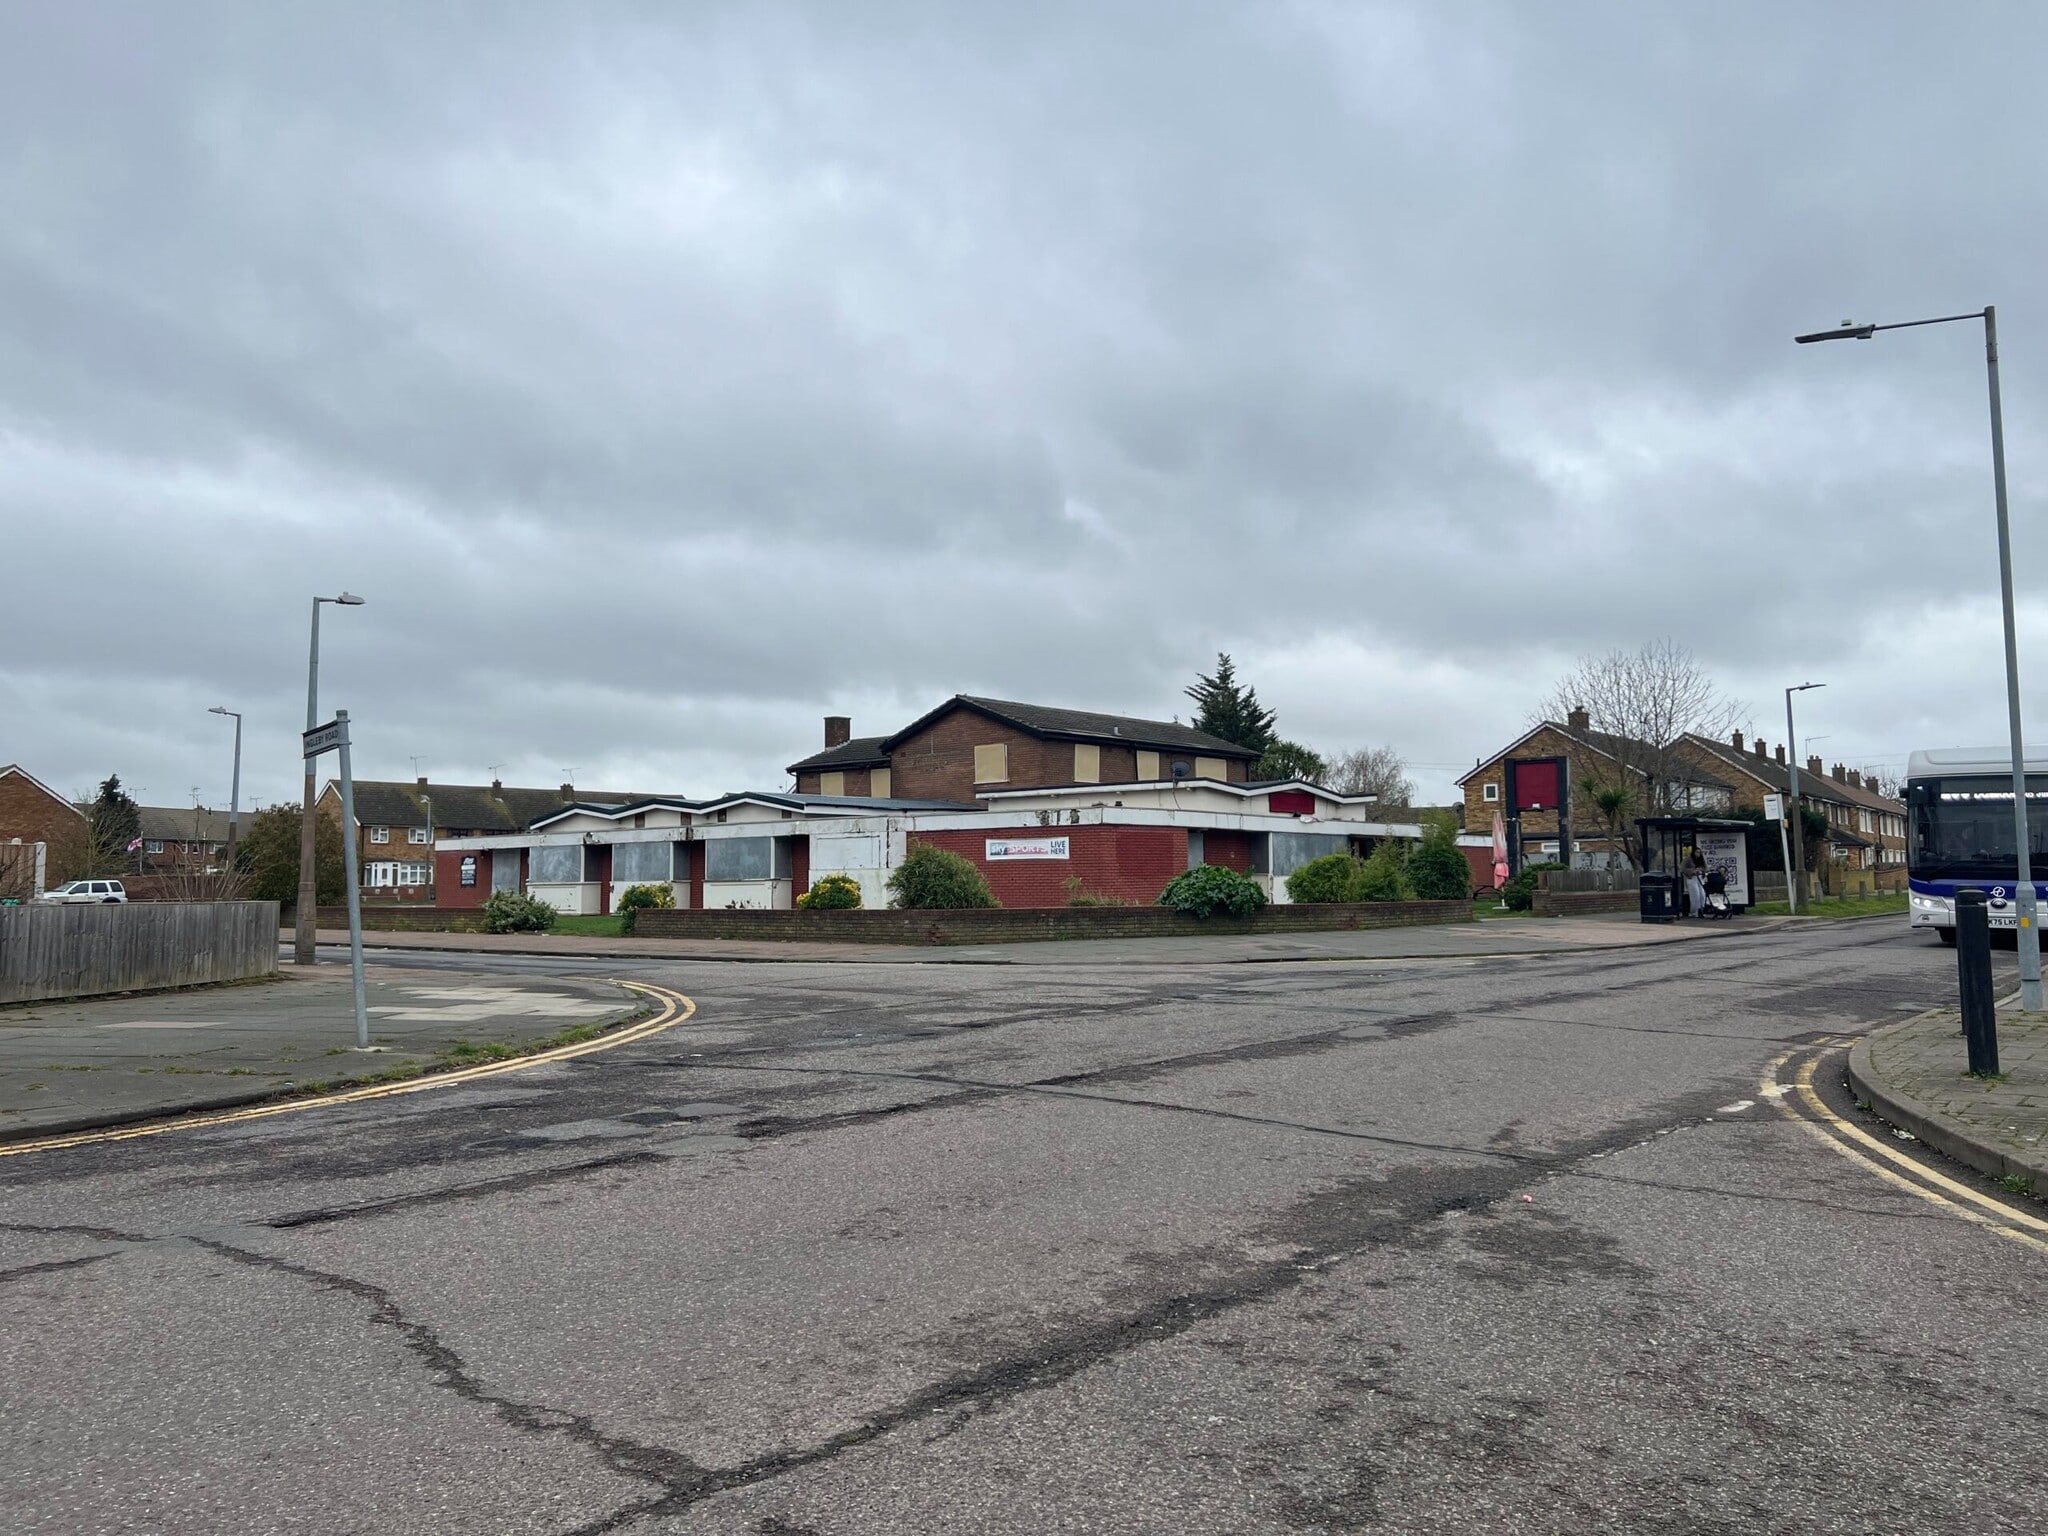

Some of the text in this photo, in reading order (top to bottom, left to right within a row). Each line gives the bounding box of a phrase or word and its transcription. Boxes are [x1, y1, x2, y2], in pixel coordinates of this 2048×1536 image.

[325, 729, 338, 742] ROAD
[991, 844, 1048, 855] sky SPORTS
[1050, 840, 1066, 848] LIVE
